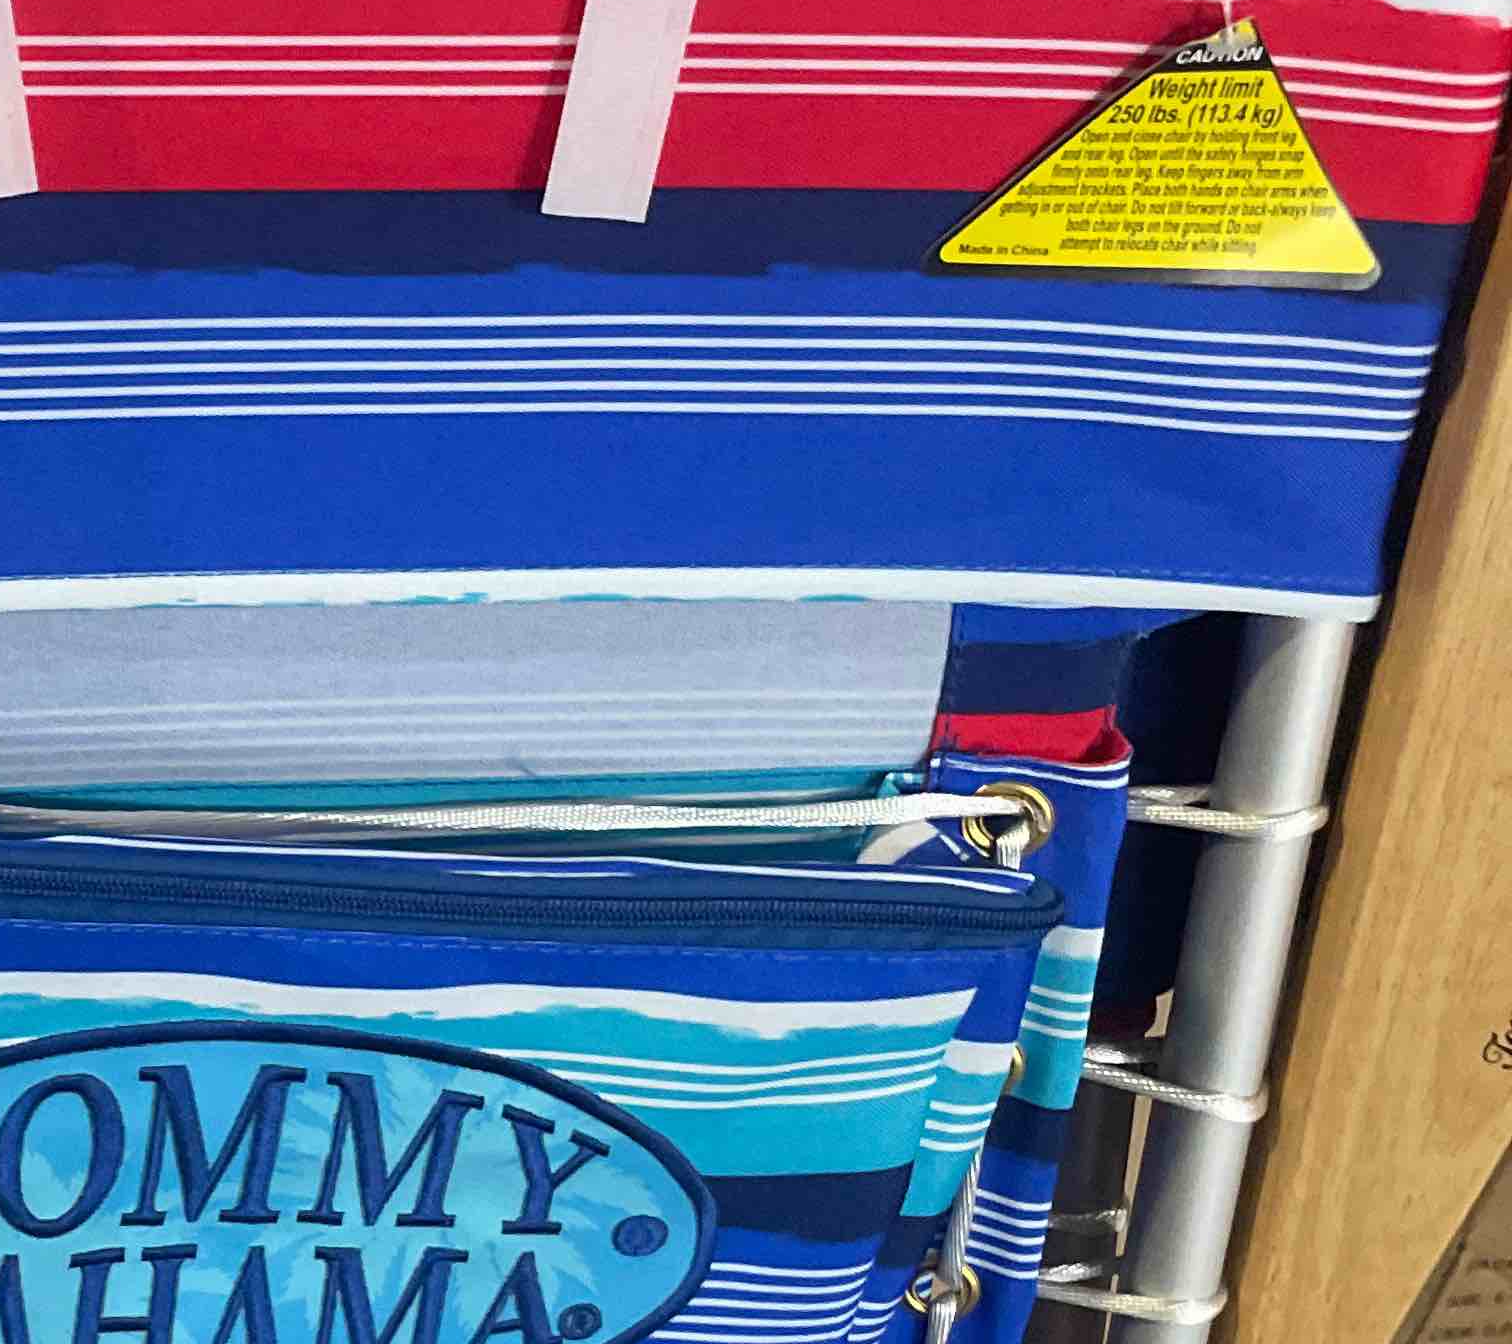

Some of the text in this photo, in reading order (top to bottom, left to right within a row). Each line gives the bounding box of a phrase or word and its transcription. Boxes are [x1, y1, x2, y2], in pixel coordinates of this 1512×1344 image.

[1149, 76, 1265, 104] Weight limit
[1107, 104, 1284, 129] 250 lbs. (113.4 kg)
[959, 244, 1049, 256] Made in China
